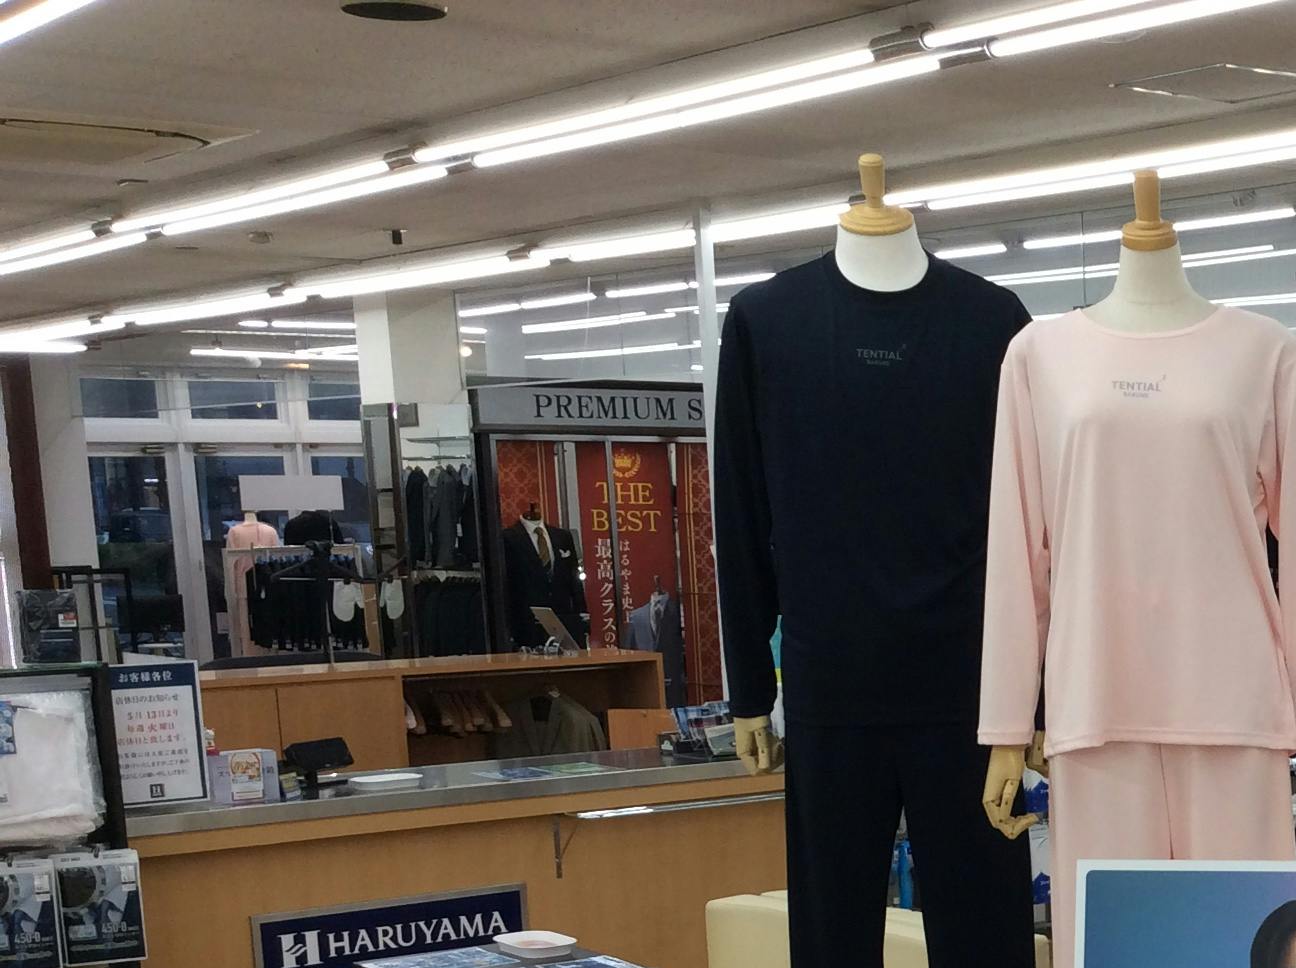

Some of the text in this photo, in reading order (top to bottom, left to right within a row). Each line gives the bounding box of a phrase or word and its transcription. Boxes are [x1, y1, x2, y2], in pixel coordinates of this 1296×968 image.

[856, 348, 903, 361] TENTIAL
[1111, 380, 1162, 393] TENTIAL
[533, 393, 676, 421] PREMIUM
[595, 482, 655, 505] THE
[591, 509, 662, 533] BEST
[118, 671, 173, 683] お客様各位
[328, 910, 509, 958] HARUYAMA
